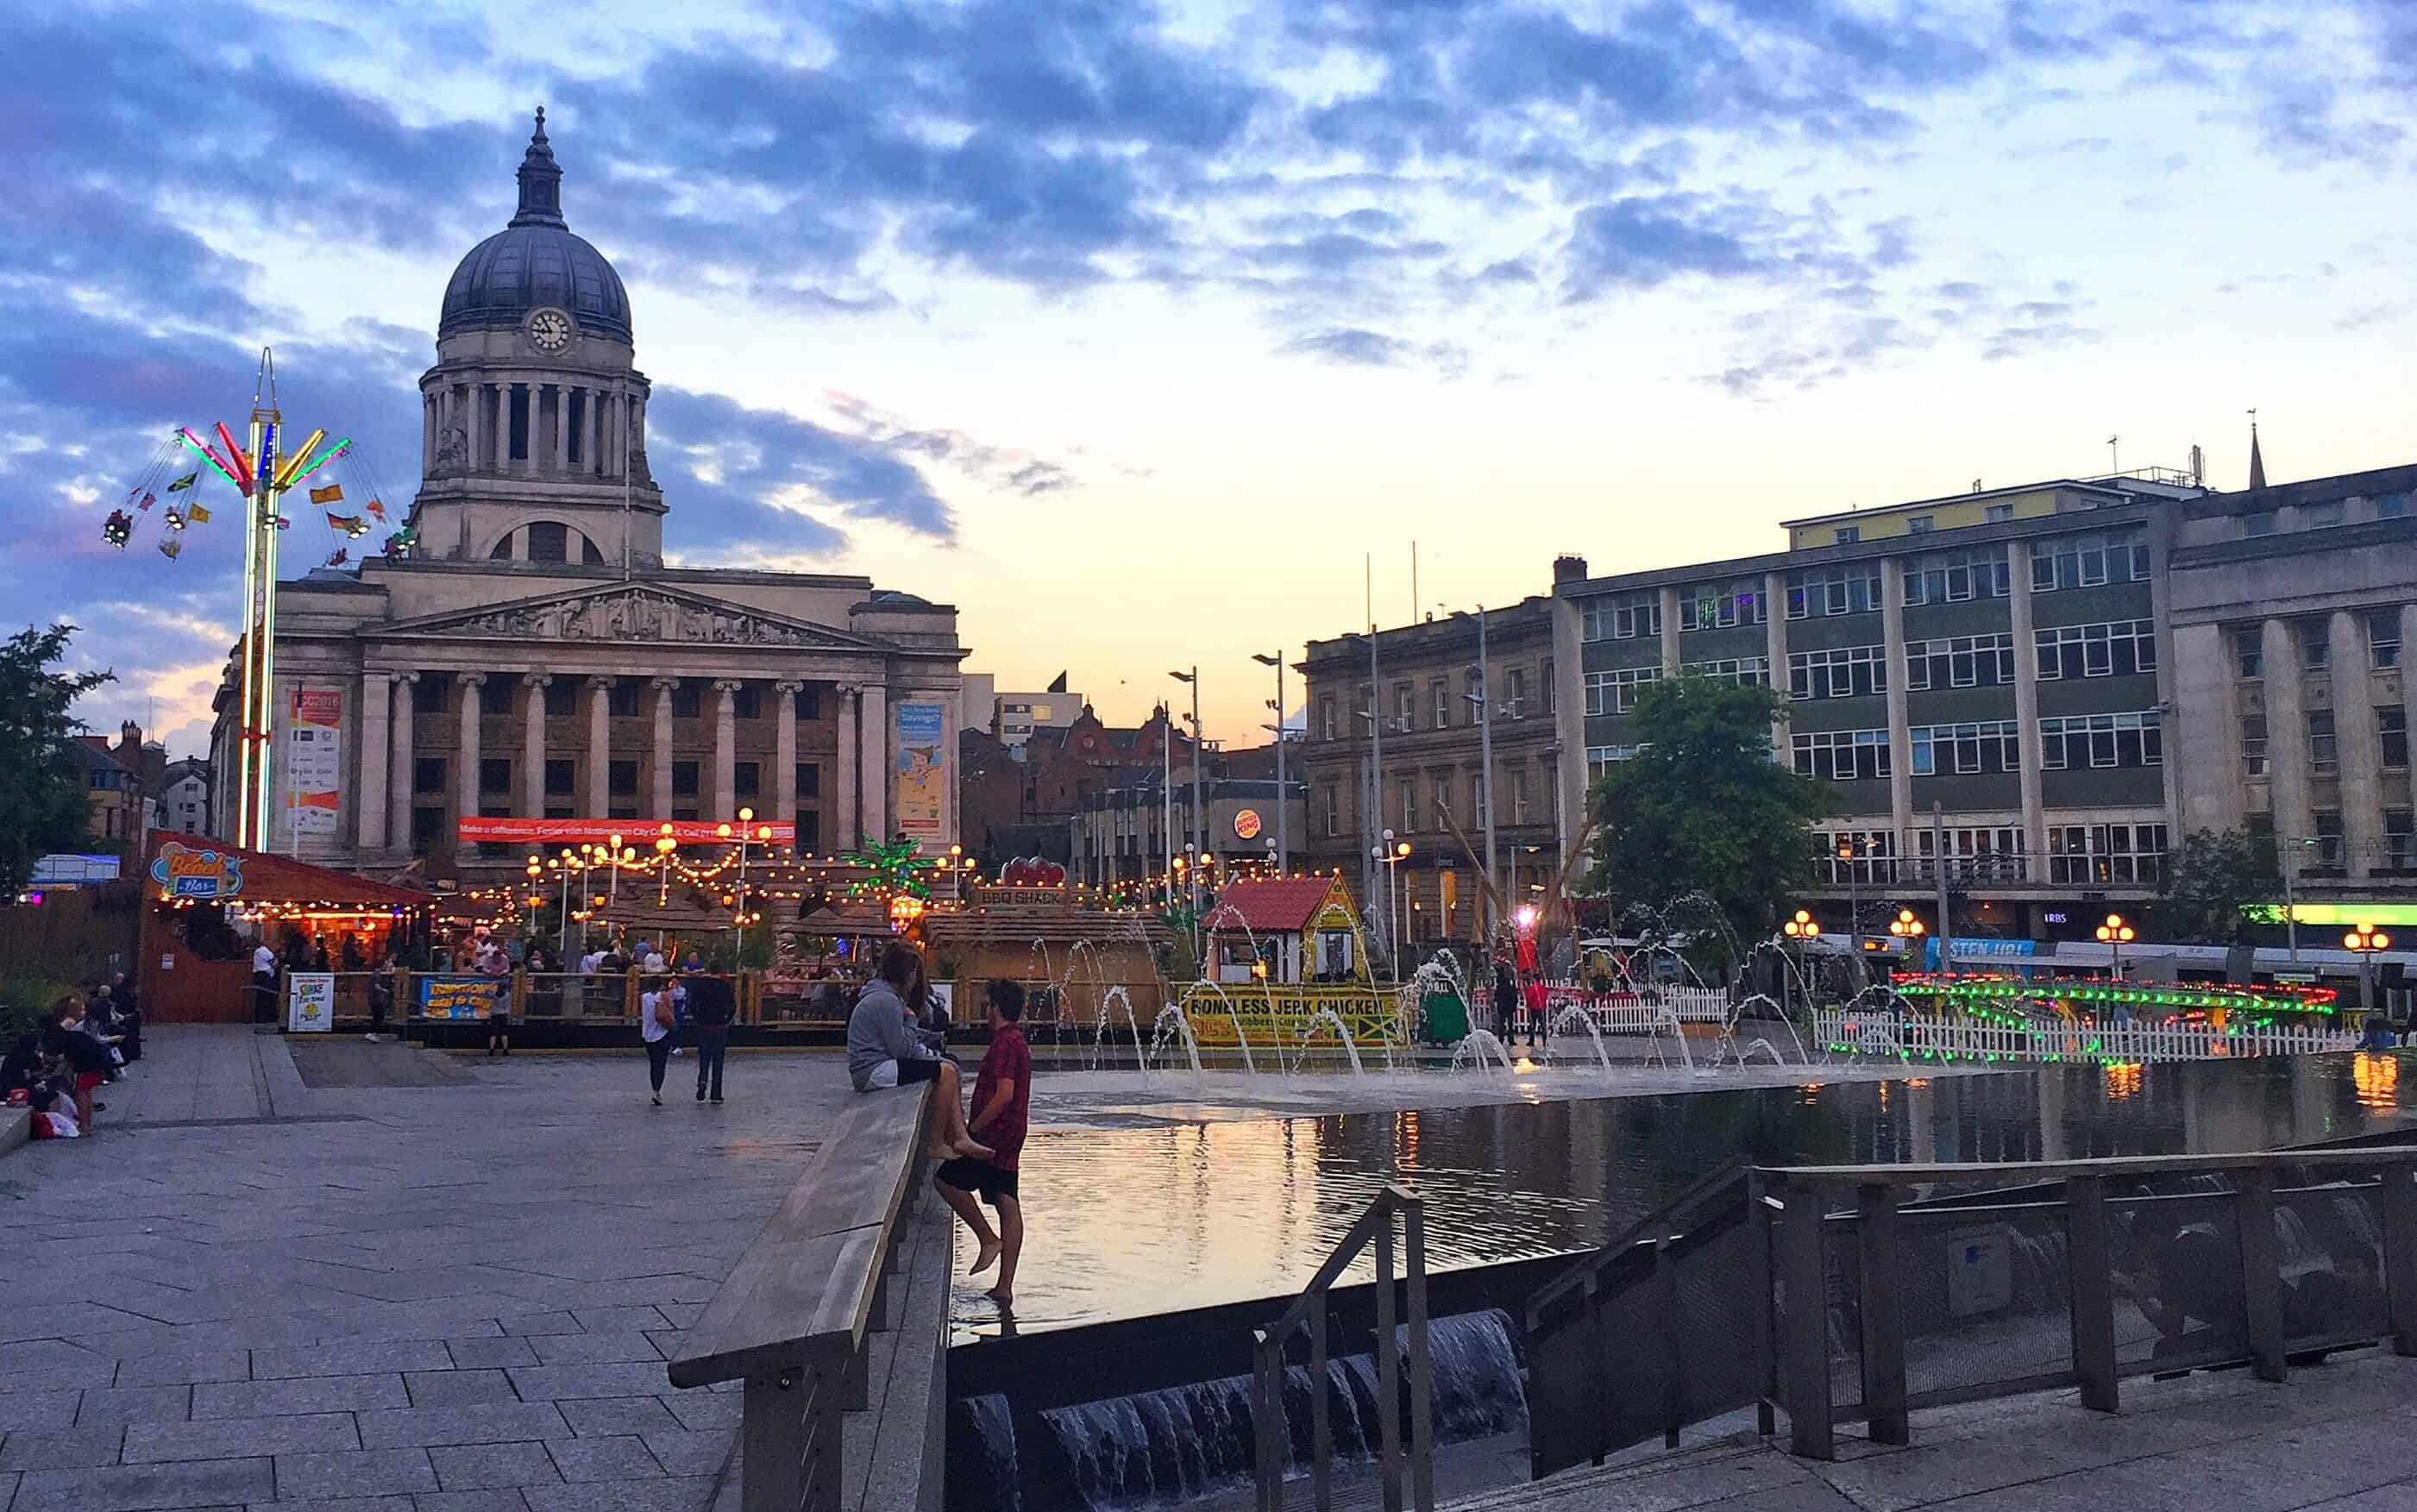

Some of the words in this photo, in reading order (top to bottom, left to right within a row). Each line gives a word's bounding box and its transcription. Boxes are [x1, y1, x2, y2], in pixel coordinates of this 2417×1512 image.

[633, 828, 649, 837] City
[171, 854, 224, 875] Beach
[185, 879, 208, 893] Bar
[982, 892, 1011, 904] BBQ
[1015, 892, 1060, 904] SHACK
[1191, 999, 1271, 1014] BONELESS
[1275, 1000, 1312, 1015] JERK
[1317, 1000, 1382, 1015] CHICKEN
